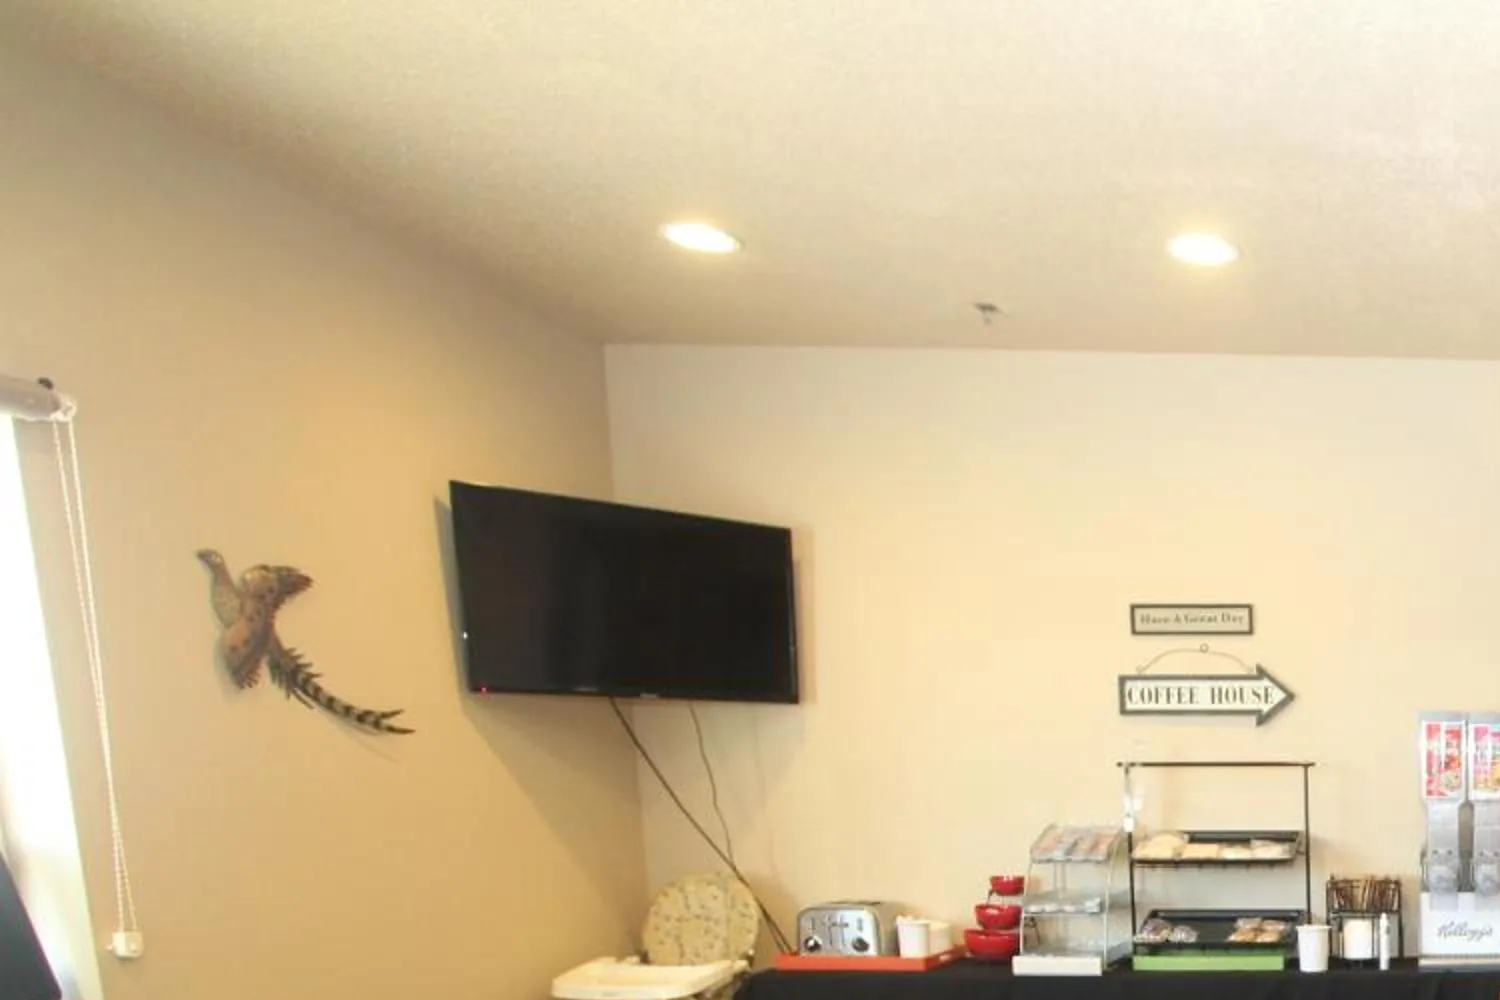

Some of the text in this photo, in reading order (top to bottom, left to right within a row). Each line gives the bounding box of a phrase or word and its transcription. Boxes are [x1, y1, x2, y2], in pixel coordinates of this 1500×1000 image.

[1221, 611, 1244, 626] Day
[1127, 686, 1274, 705] COFFEE HOUSE
